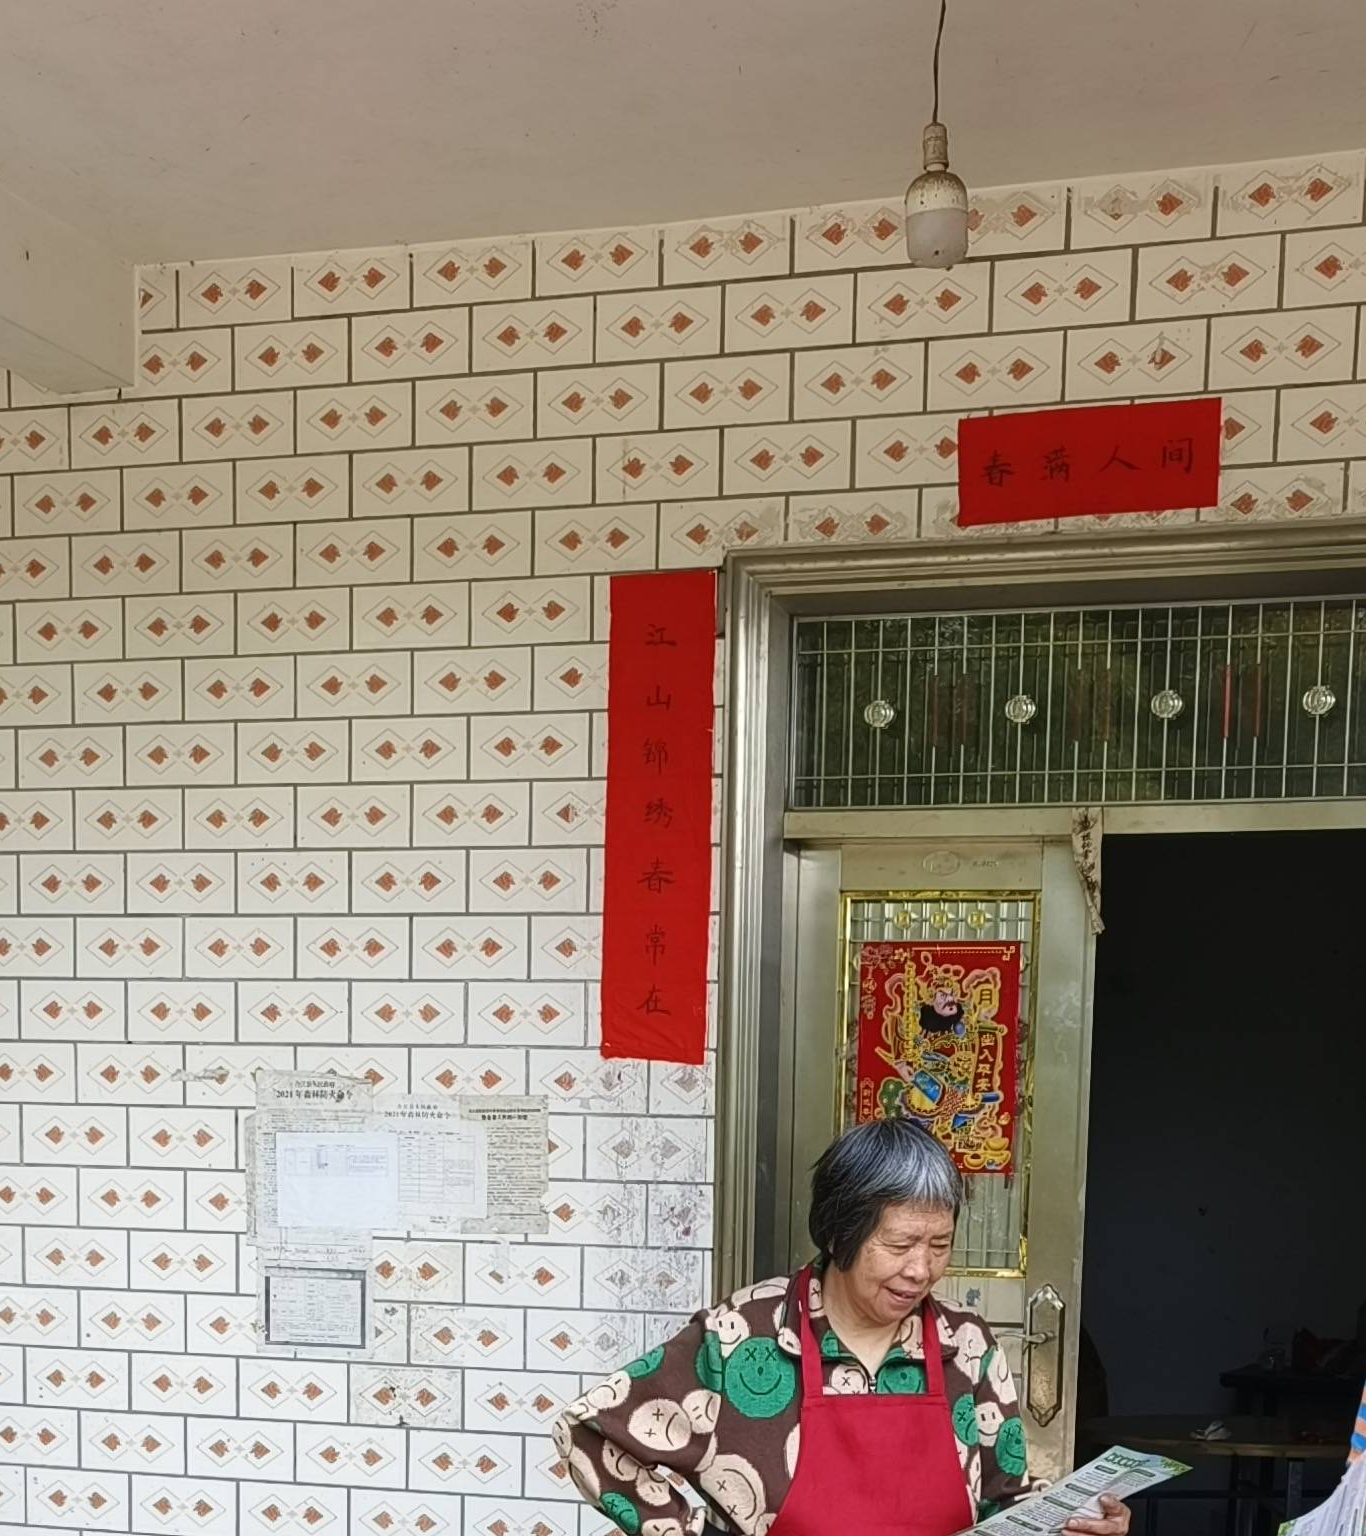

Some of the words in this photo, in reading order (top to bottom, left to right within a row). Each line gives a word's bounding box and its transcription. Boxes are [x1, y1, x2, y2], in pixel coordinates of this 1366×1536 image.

[982, 437, 1194, 487] 春满人间
[637, 623, 678, 1016] 江山锦绣春常在
[978, 988, 993, 1005] 月
[975, 1033, 996, 1092] 出入平安
